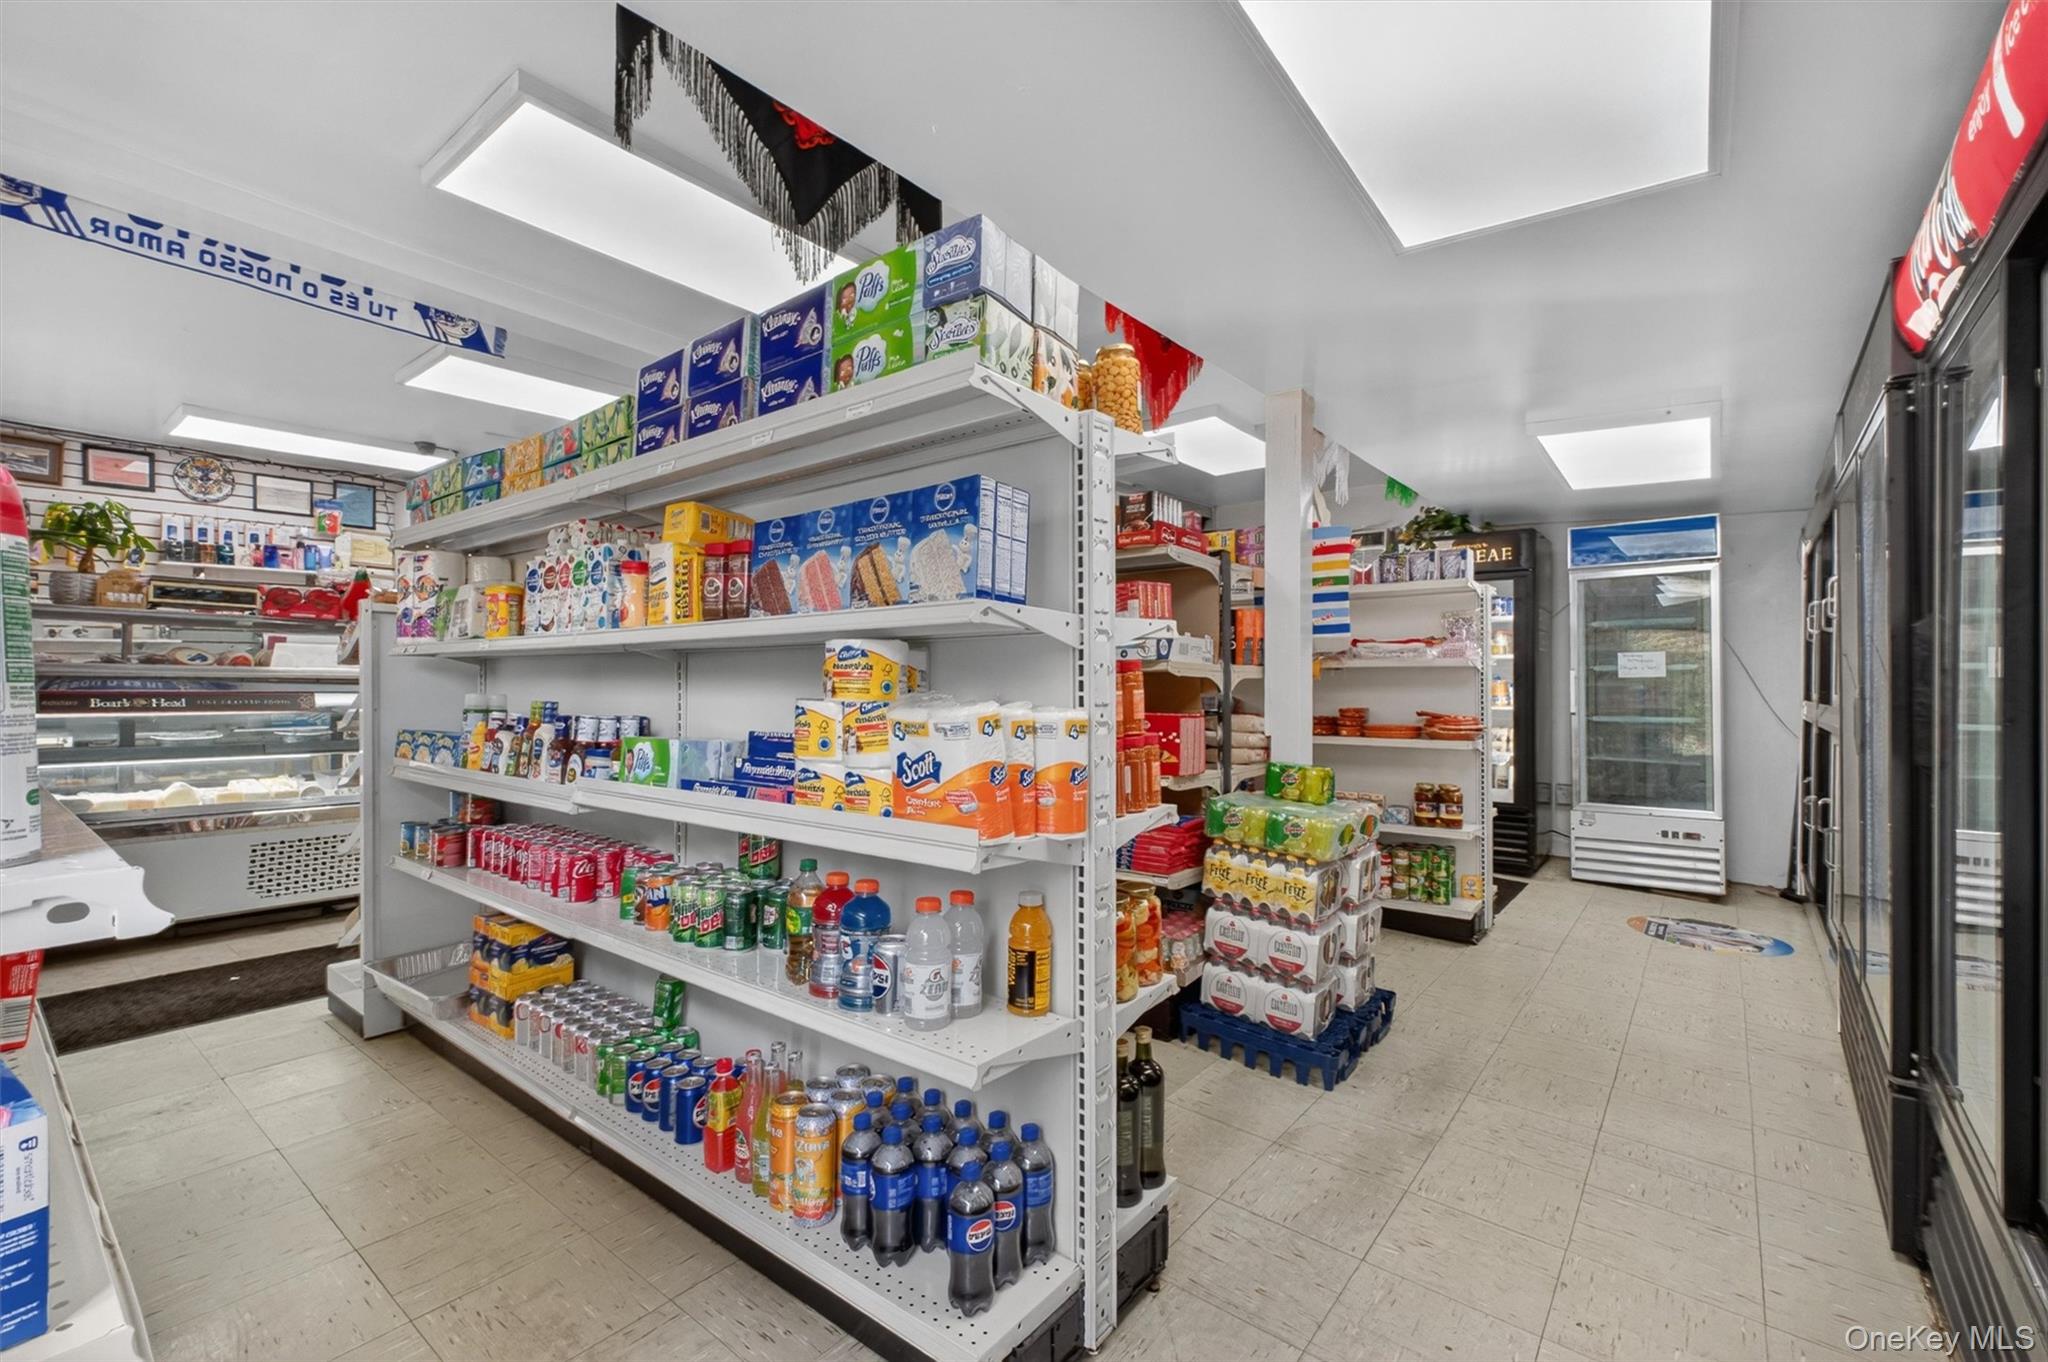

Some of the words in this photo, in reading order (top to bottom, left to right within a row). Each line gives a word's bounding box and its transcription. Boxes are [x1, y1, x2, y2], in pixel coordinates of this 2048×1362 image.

[859, 272, 884, 302] Puffs
[856, 345, 881, 377] Puffs
[151, 697, 186, 708] Head
[902, 751, 935, 784] Scott
